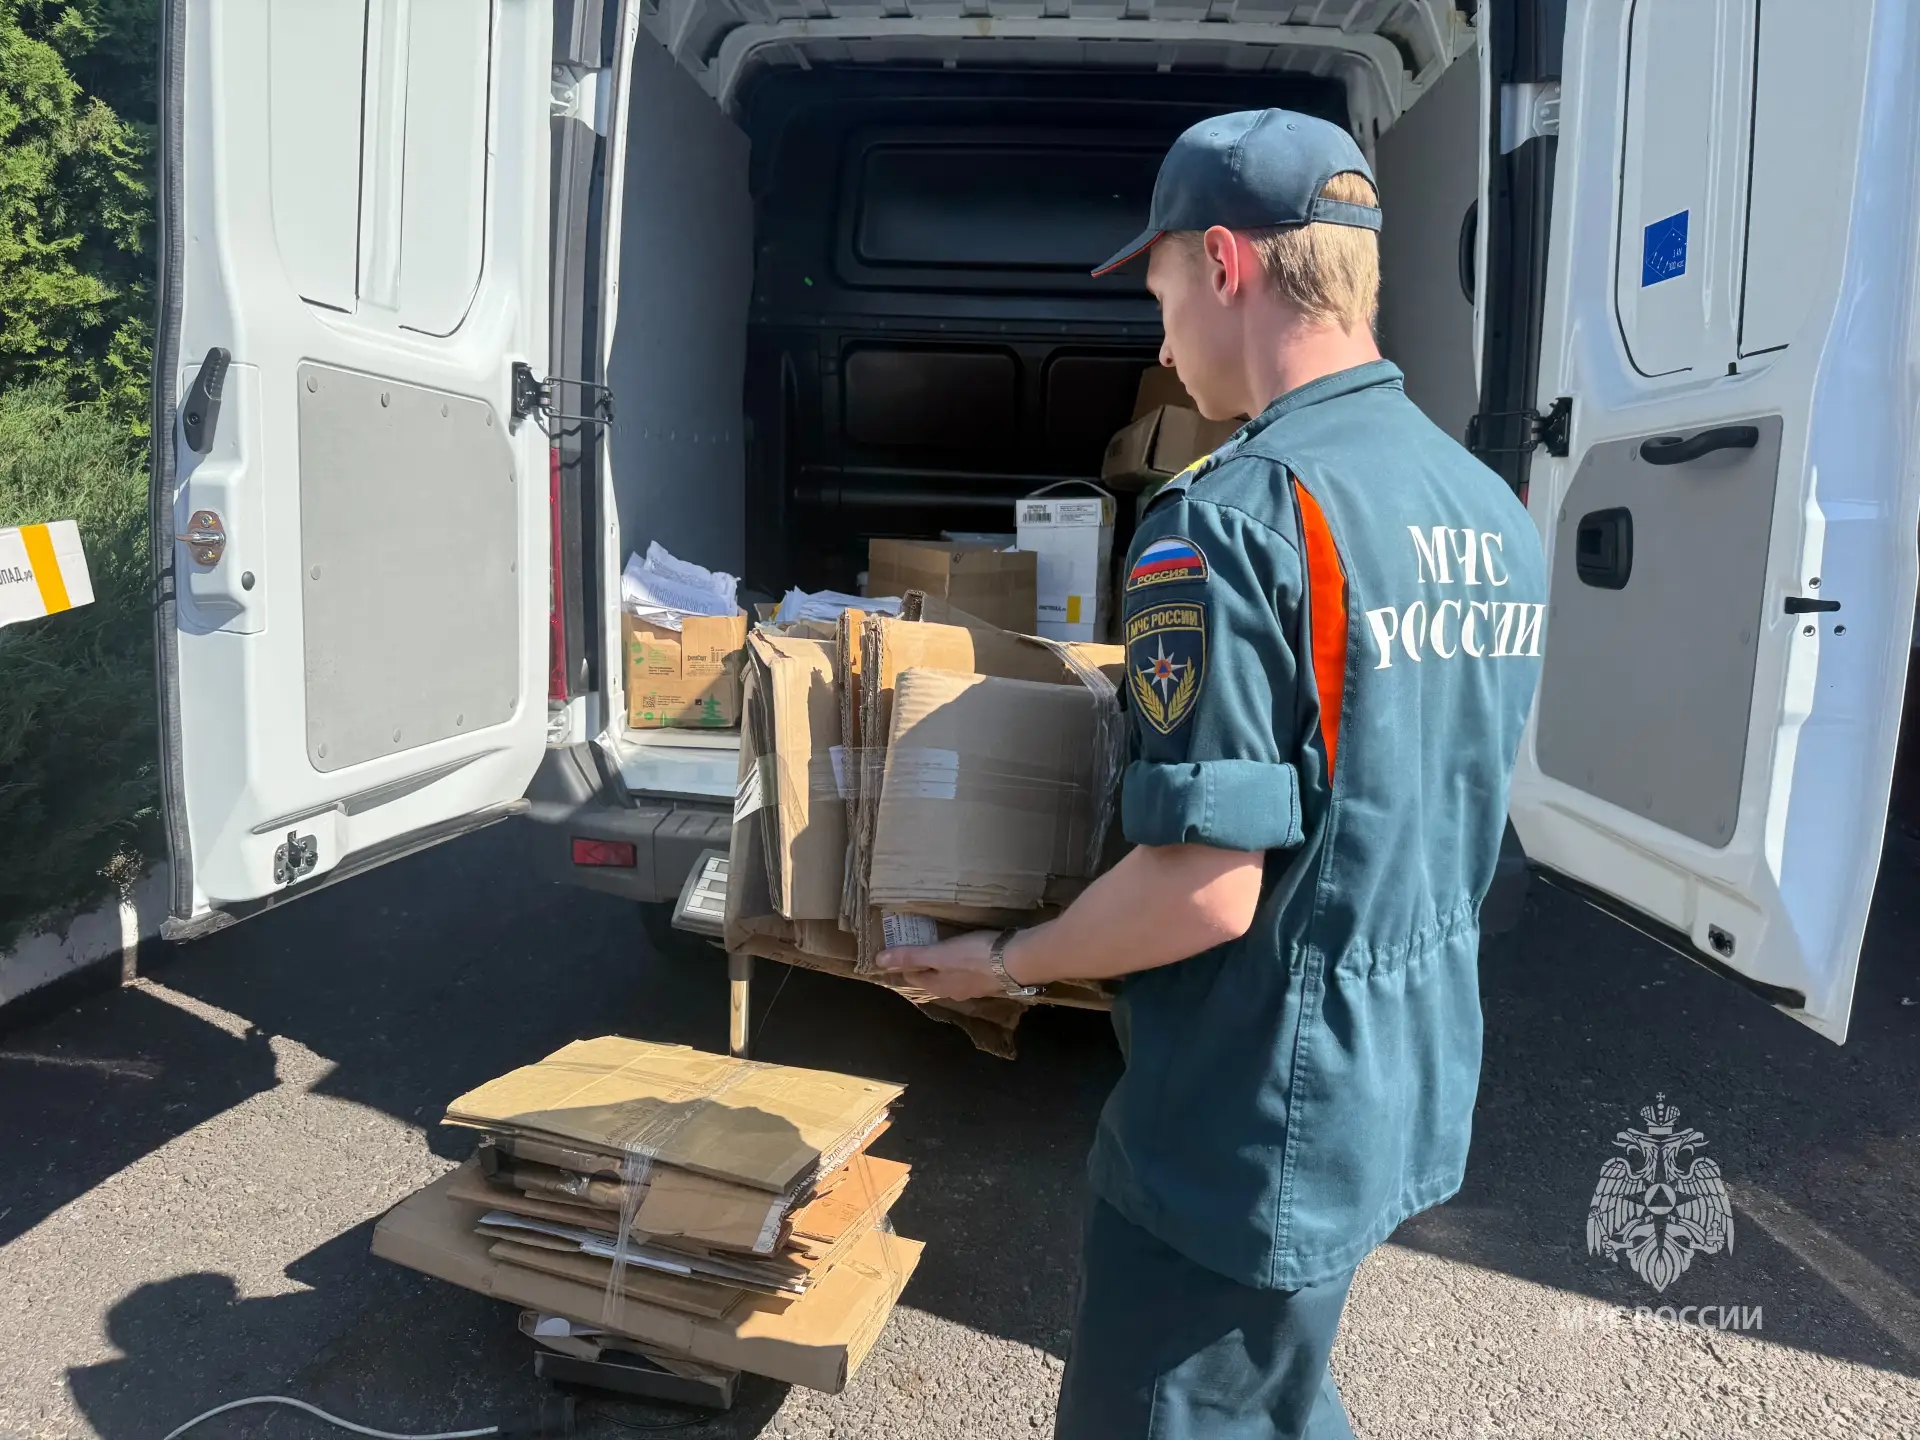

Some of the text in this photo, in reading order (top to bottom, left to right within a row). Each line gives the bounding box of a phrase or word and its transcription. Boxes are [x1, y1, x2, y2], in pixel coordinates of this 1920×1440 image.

[1137, 568, 1189, 585] РОССИЯ
[1407, 525, 1508, 586] МЧС
[1130, 609, 1198, 637] МЧС РОССИИ
[1365, 599, 1546, 669] РОССИИ
